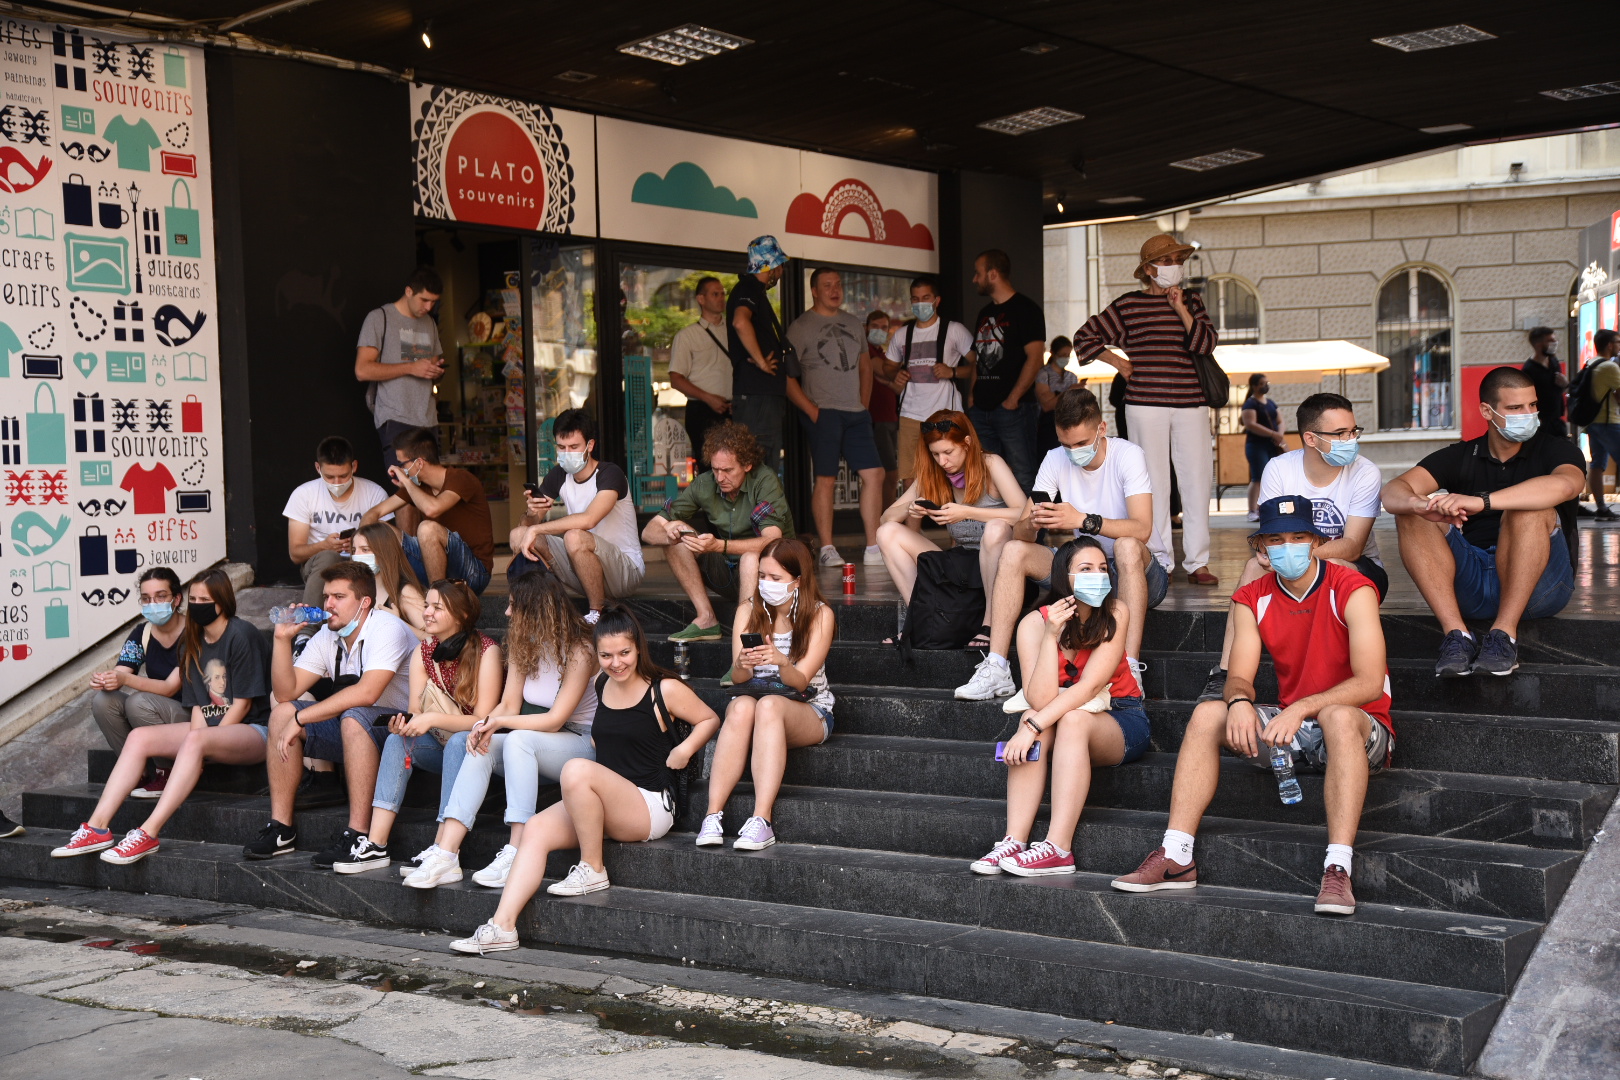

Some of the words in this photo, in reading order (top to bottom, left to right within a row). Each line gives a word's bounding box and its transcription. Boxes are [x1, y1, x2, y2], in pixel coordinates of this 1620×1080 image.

[4, 51, 37, 66] jewelry
[4, 71, 47, 87] paintings
[6, 91, 43, 104] handicraft
[93, 79, 193, 116] souvenirs
[458, 155, 535, 184] PLATO
[459, 188, 535, 208] souvenirs
[148, 259, 200, 280] guides
[149, 284, 201, 299] postcards
[111, 435, 209, 457] souvenirs
[147, 517, 198, 541] gifts
[148, 549, 198, 566] jewelry
